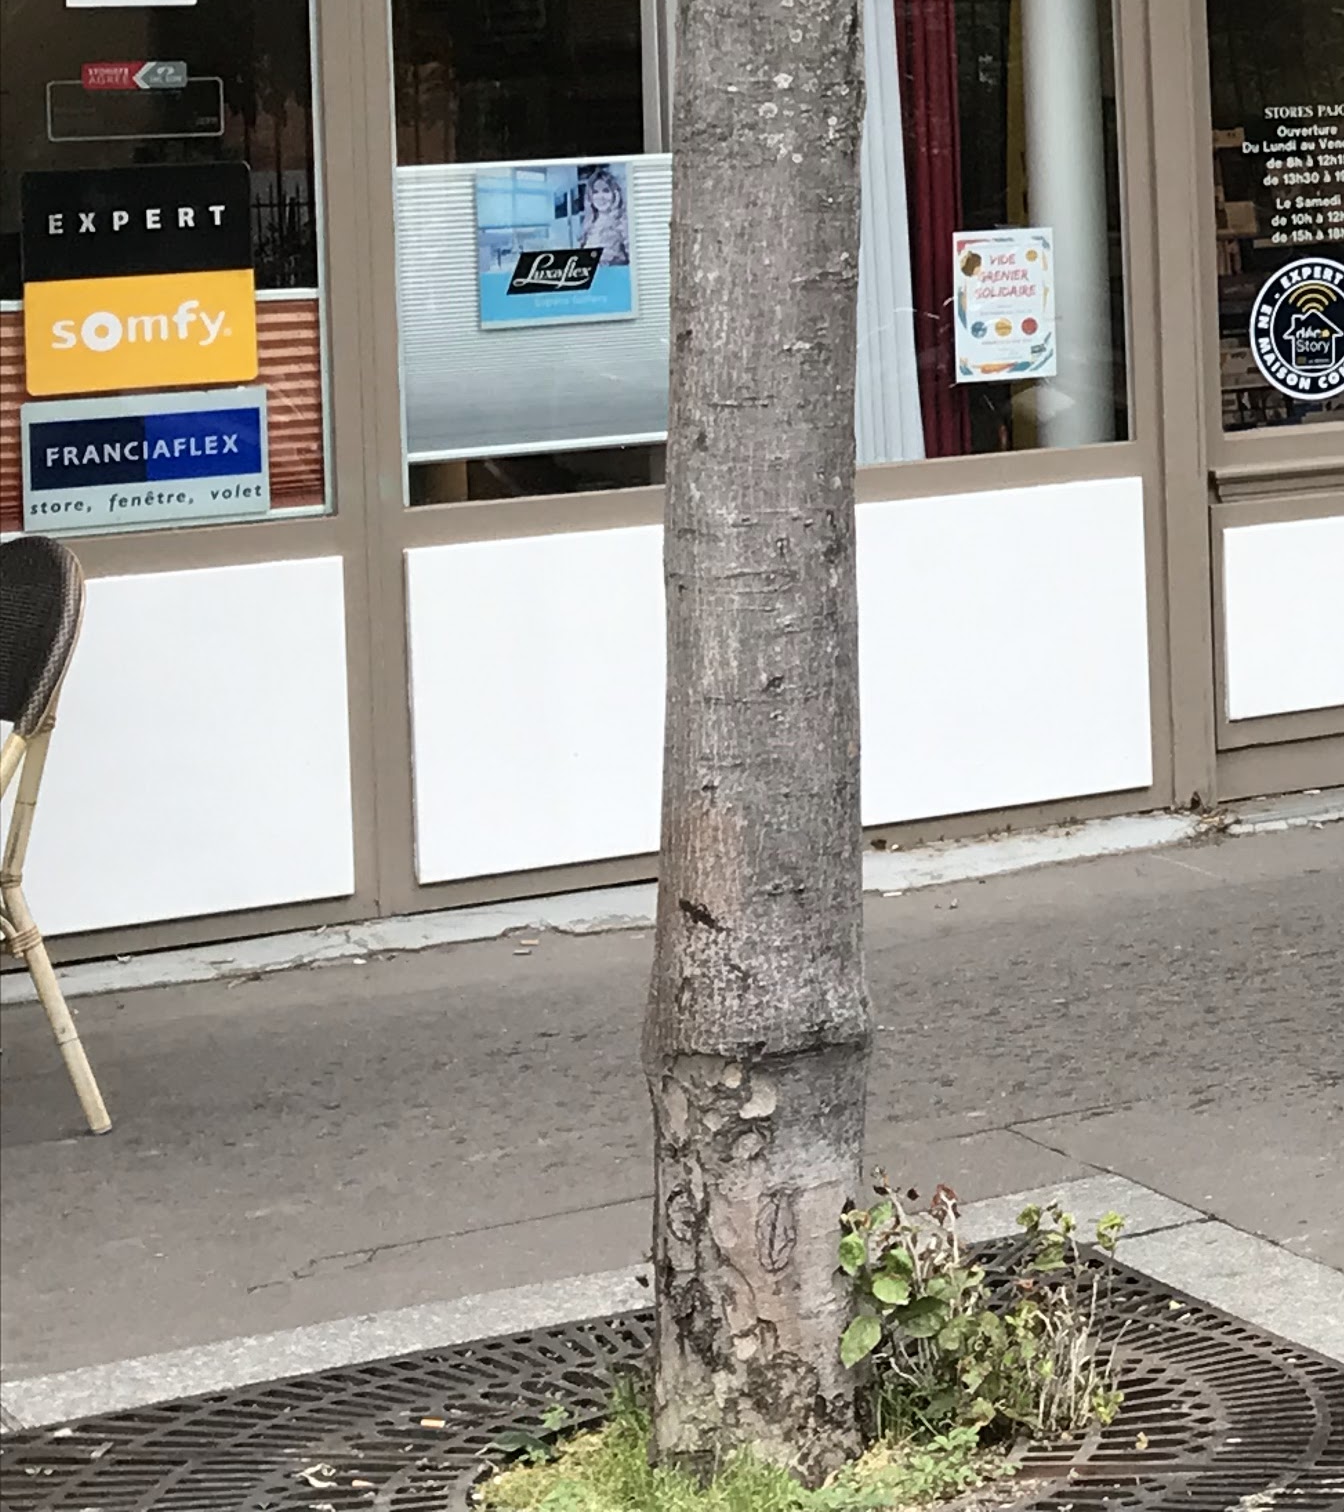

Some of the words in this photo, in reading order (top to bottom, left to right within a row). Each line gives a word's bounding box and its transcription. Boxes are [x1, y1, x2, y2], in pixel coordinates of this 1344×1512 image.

[1264, 105, 1314, 119] STORES
[1276, 124, 1338, 138] Ouverture
[1242, 141, 1260, 153] Du
[1263, 139, 1297, 153] Lundi
[1300, 141, 1315, 151] au
[1265, 157, 1283, 169] de
[1306, 154, 1314, 167] à
[1263, 174, 1279, 186] de
[1282, 172, 1320, 185] 13h30
[1323, 170, 1331, 183] à
[1275, 197, 1291, 210] Le
[1295, 194, 1342, 208] Samedi
[48, 204, 227, 235] EXPERT
[1271, 215, 1288, 227] de
[1291, 213, 1313, 225] 10h
[1316, 212, 1323, 224] à
[1271, 232, 1288, 243] de
[1291, 229, 1313, 242] 15h
[1316, 228, 1324, 241] à
[989, 253, 1016, 265] VIDE
[512, 253, 592, 289] Luxaflex
[1279, 266, 1344, 289] EXPERT
[1295, 340, 1330, 354] Story
[1257, 337, 1311, 390] MAISON
[46, 433, 240, 468] FRANCIAFLEX
[29, 497, 93, 516] store,
[108, 488, 195, 513] fenêtre,
[210, 483, 263, 502] volet
